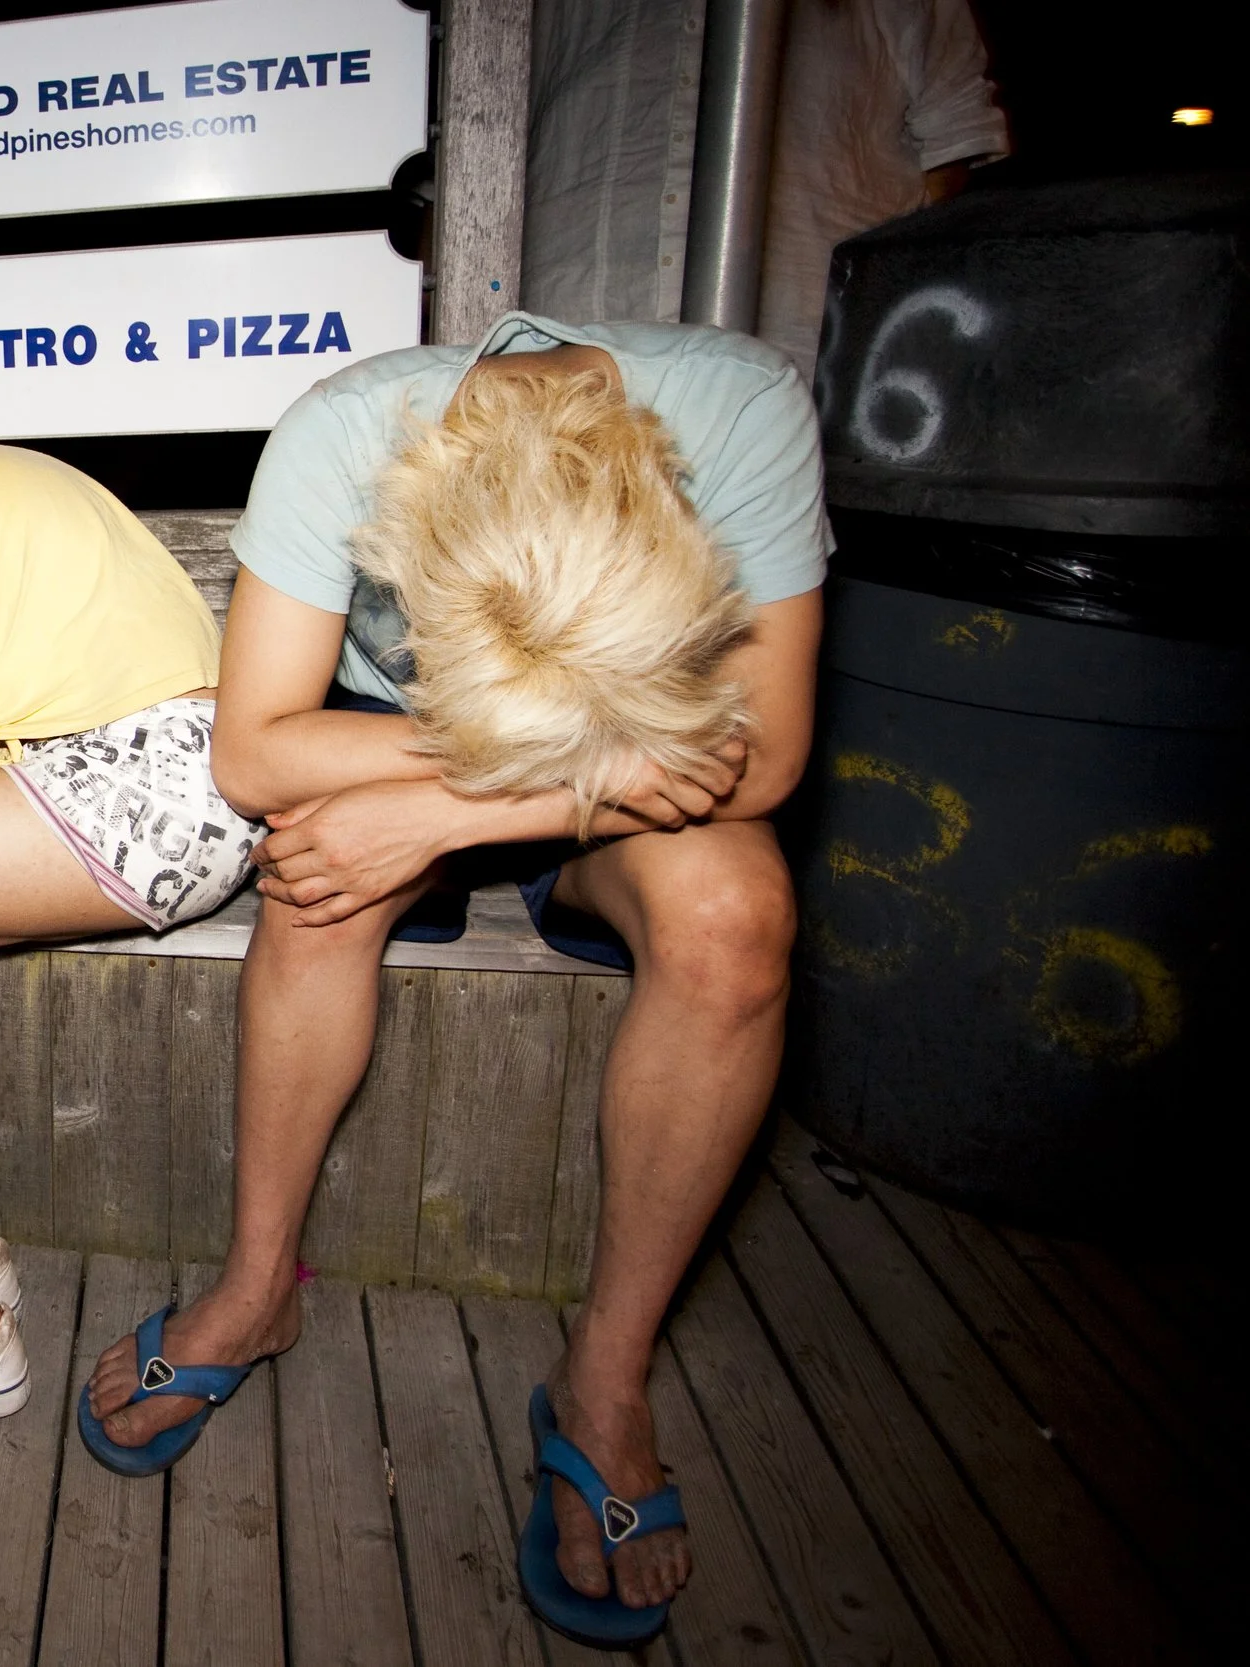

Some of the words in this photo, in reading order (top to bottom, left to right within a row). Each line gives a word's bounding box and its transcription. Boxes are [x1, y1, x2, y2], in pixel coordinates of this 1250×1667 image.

[38, 71, 165, 112] REAL
[185, 49, 371, 98] ESTATE
[125, 321, 159, 363] &
[188, 312, 352, 359] PIZZA
